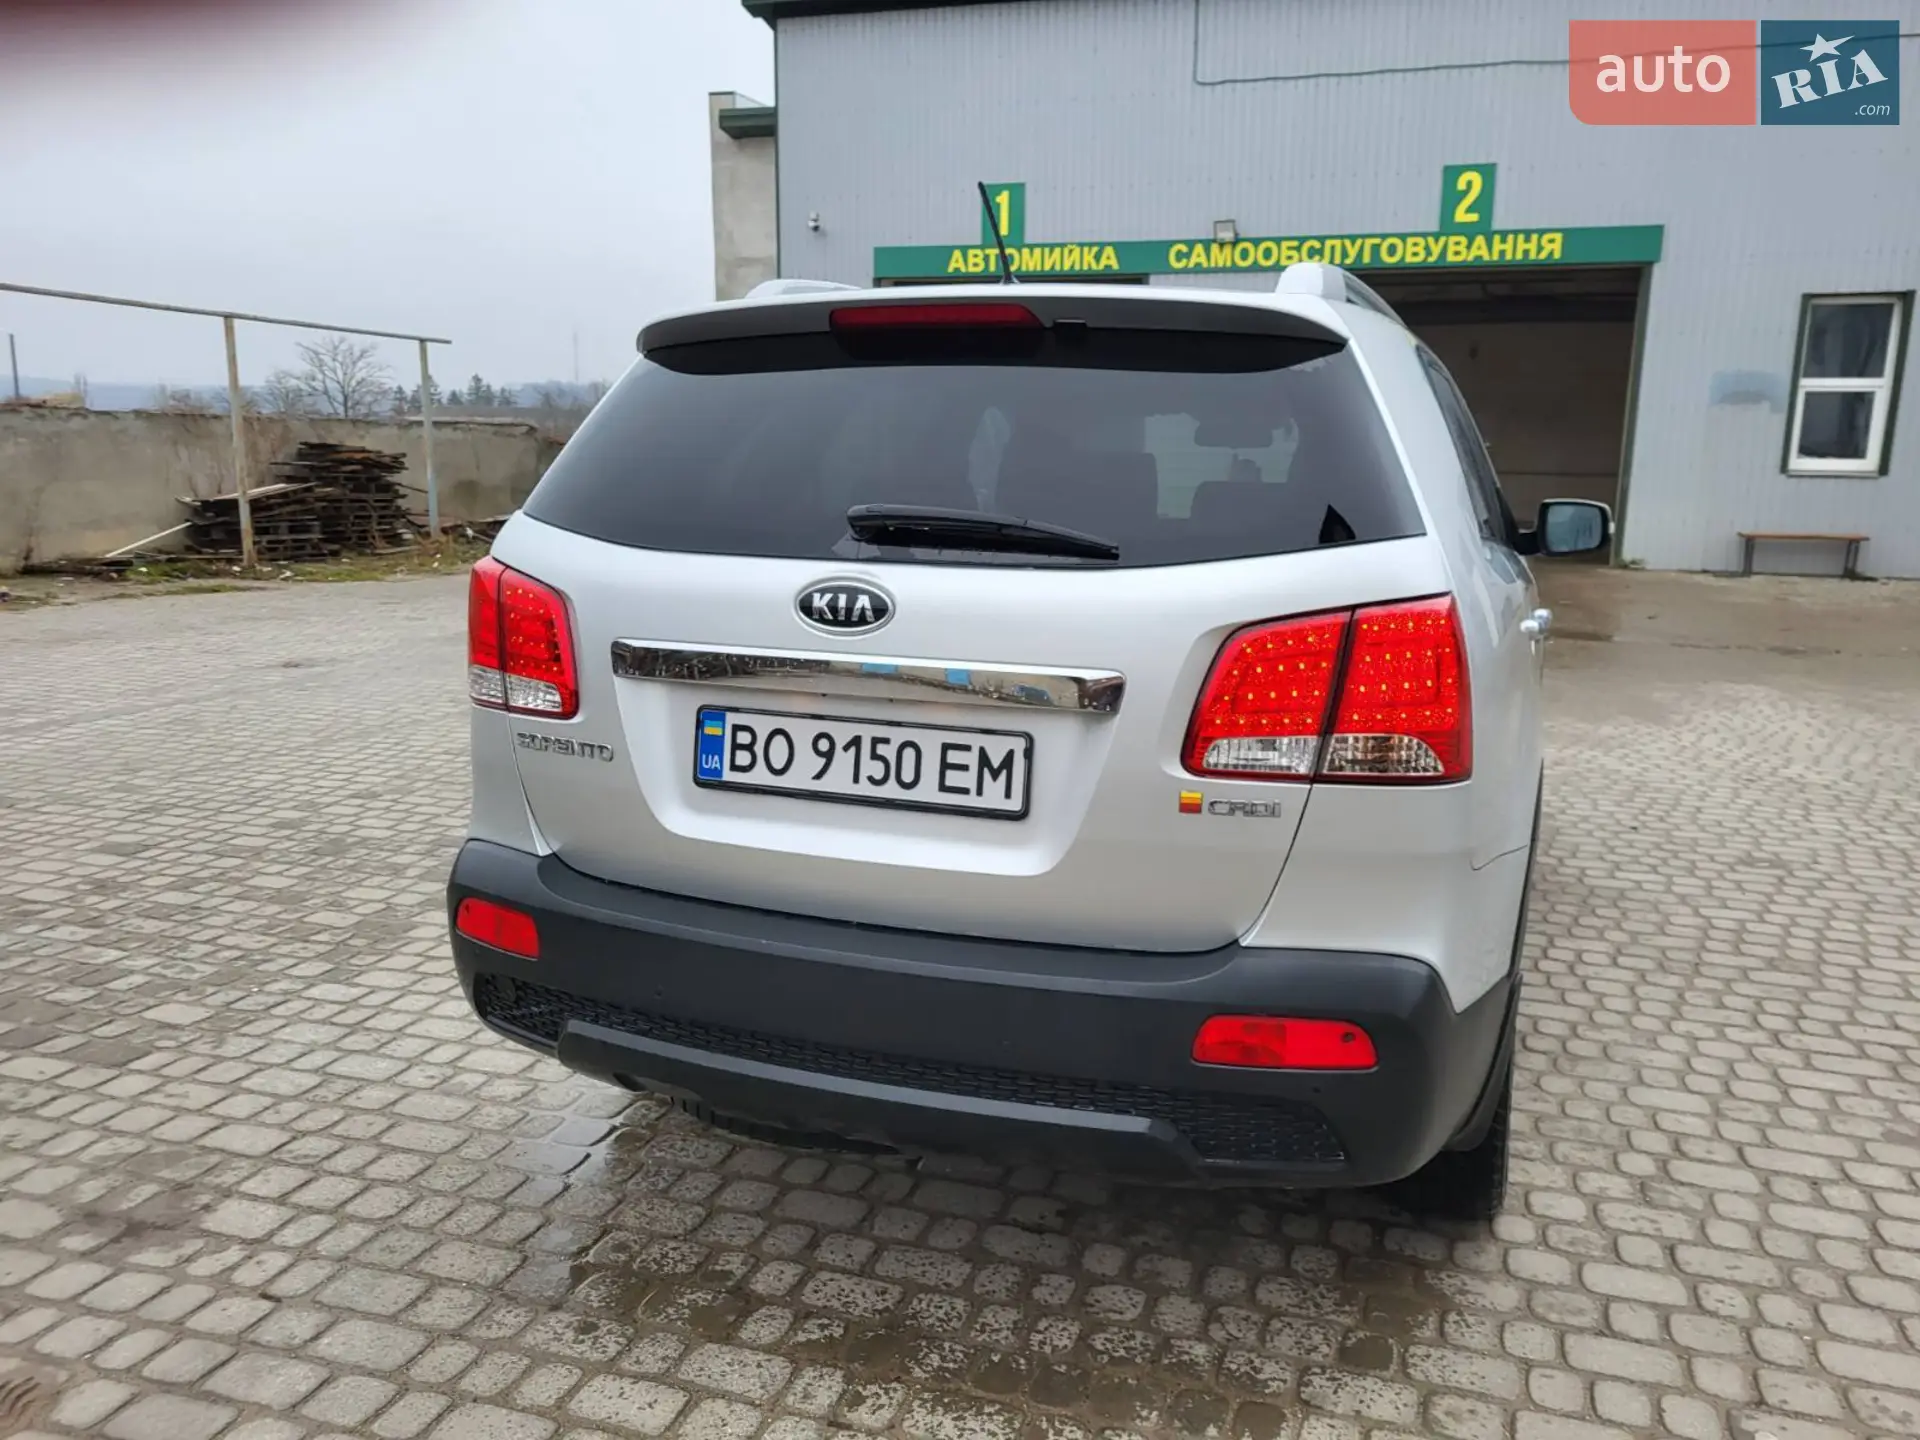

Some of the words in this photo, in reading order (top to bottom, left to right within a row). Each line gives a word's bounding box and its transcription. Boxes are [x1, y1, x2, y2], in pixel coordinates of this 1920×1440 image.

[995, 190, 1010, 236] 1
[1453, 171, 1483, 223] 2
[947, 244, 1120, 273] АВТОМИЙКА
[1168, 232, 1563, 269] САМООБСЛУГОВУВАННЯ
[812, 592, 875, 622] KIA
[702, 753, 721, 771] UA
[728, 723, 795, 777] BO
[811, 731, 922, 790] 9150
[938, 742, 1015, 800] EM
